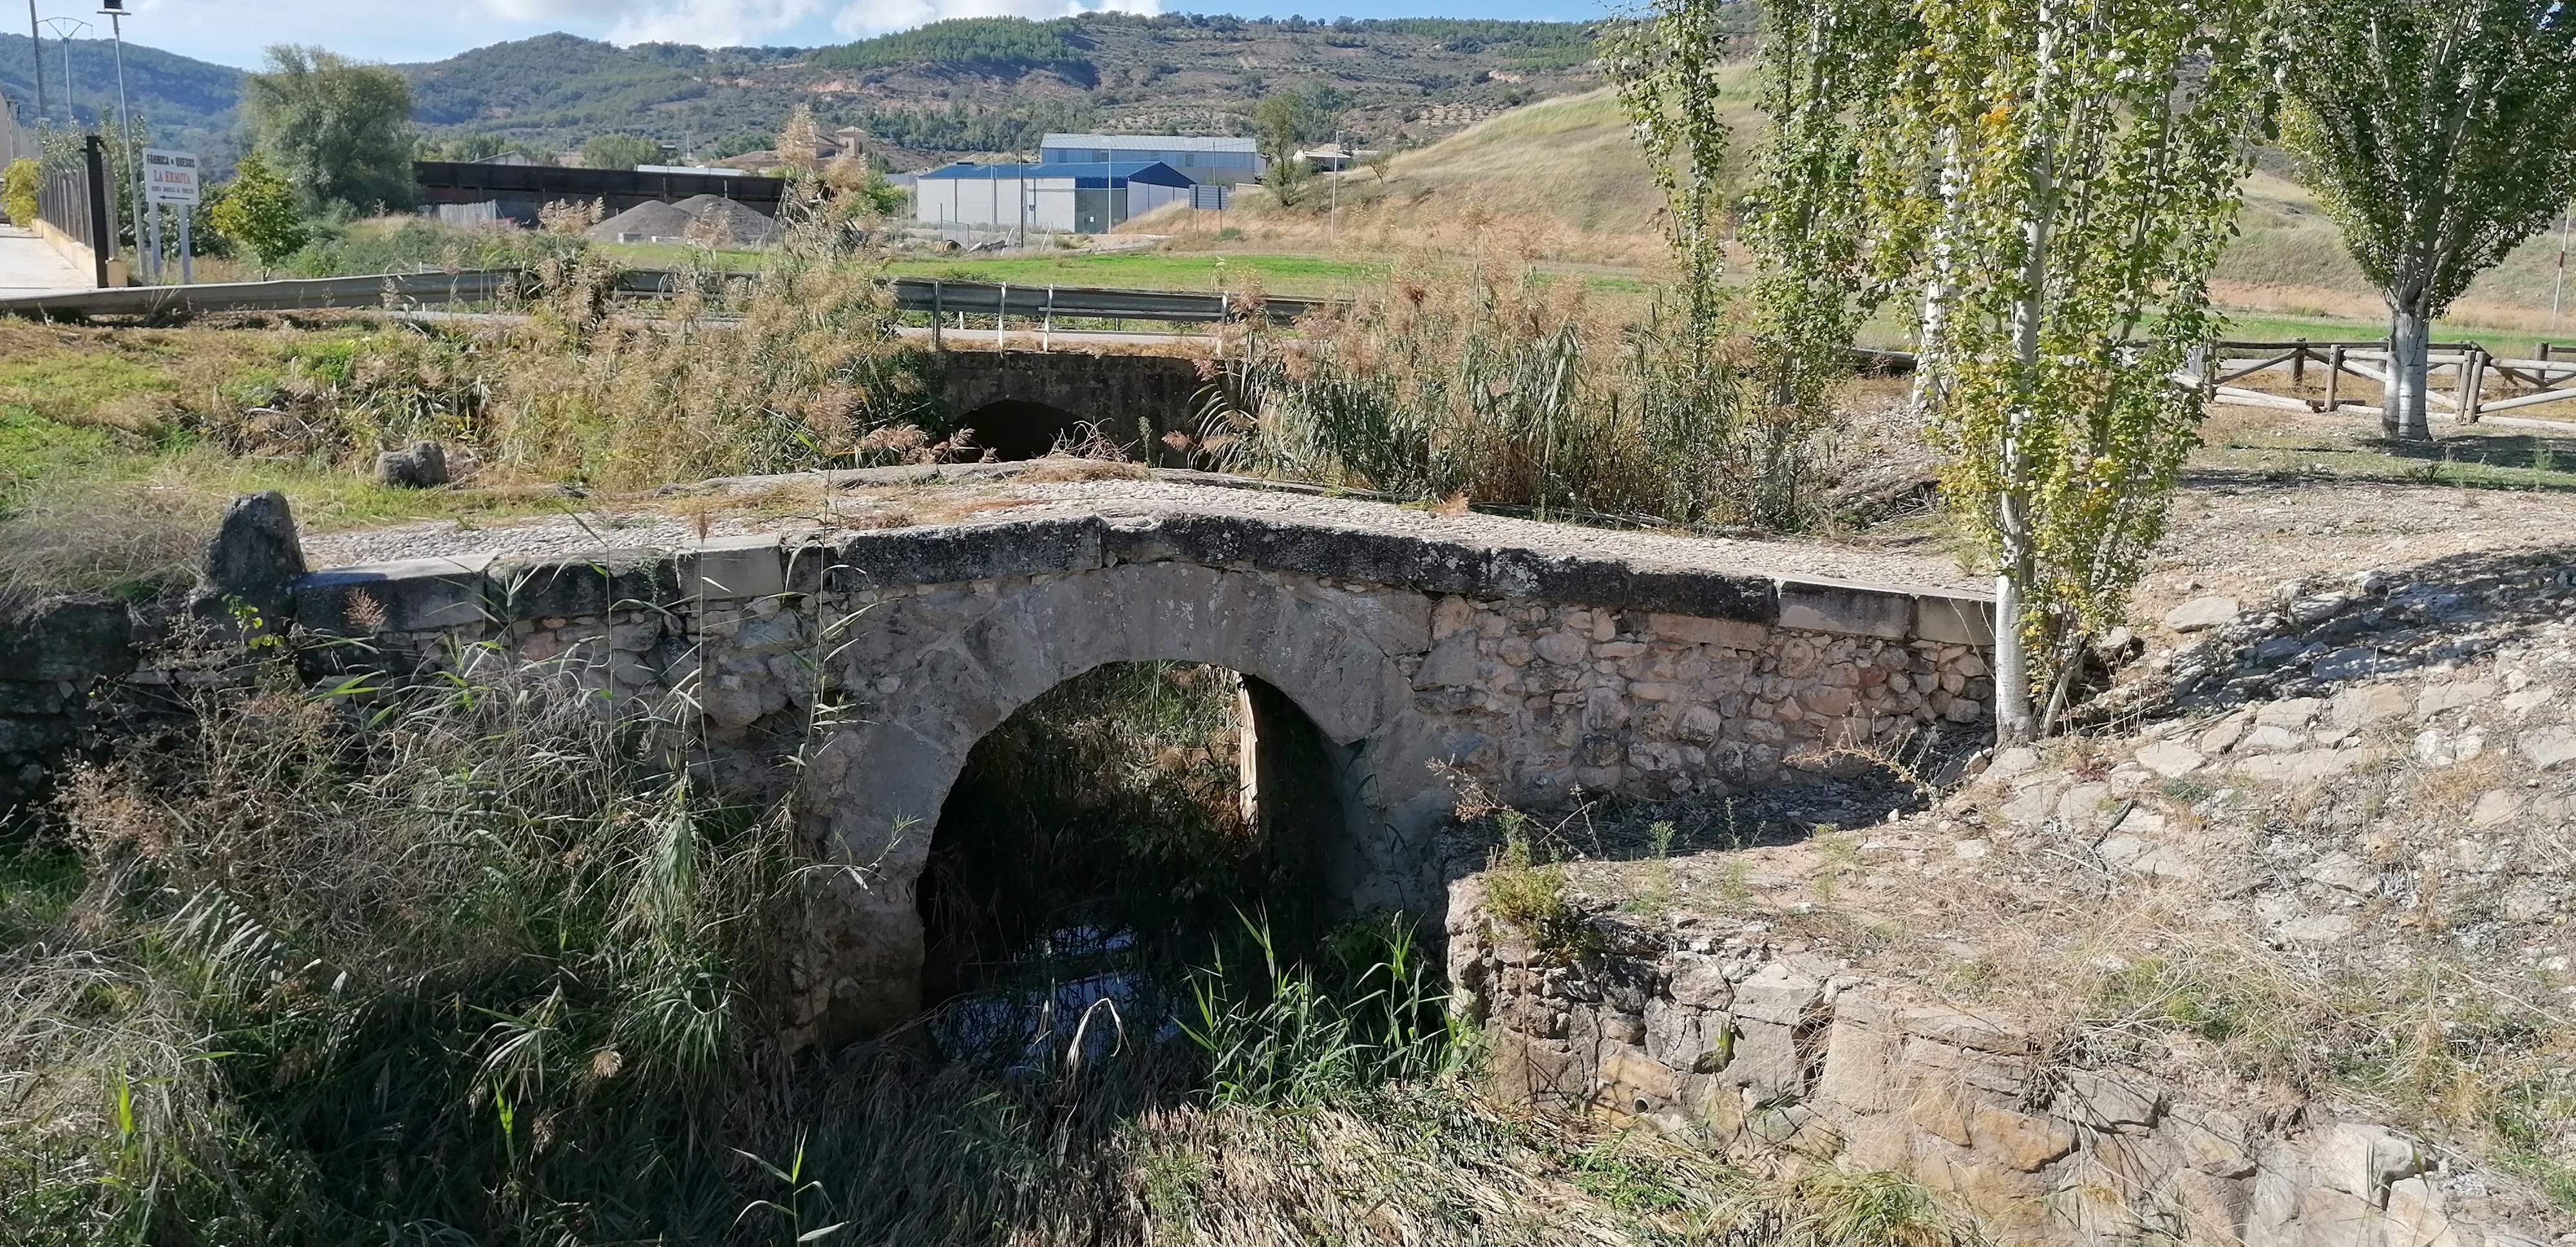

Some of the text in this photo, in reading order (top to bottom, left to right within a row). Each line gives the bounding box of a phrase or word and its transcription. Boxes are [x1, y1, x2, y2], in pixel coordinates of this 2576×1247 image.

[175, 157, 195, 168] QUESOS
[154, 169, 191, 184] LA ERMITA
